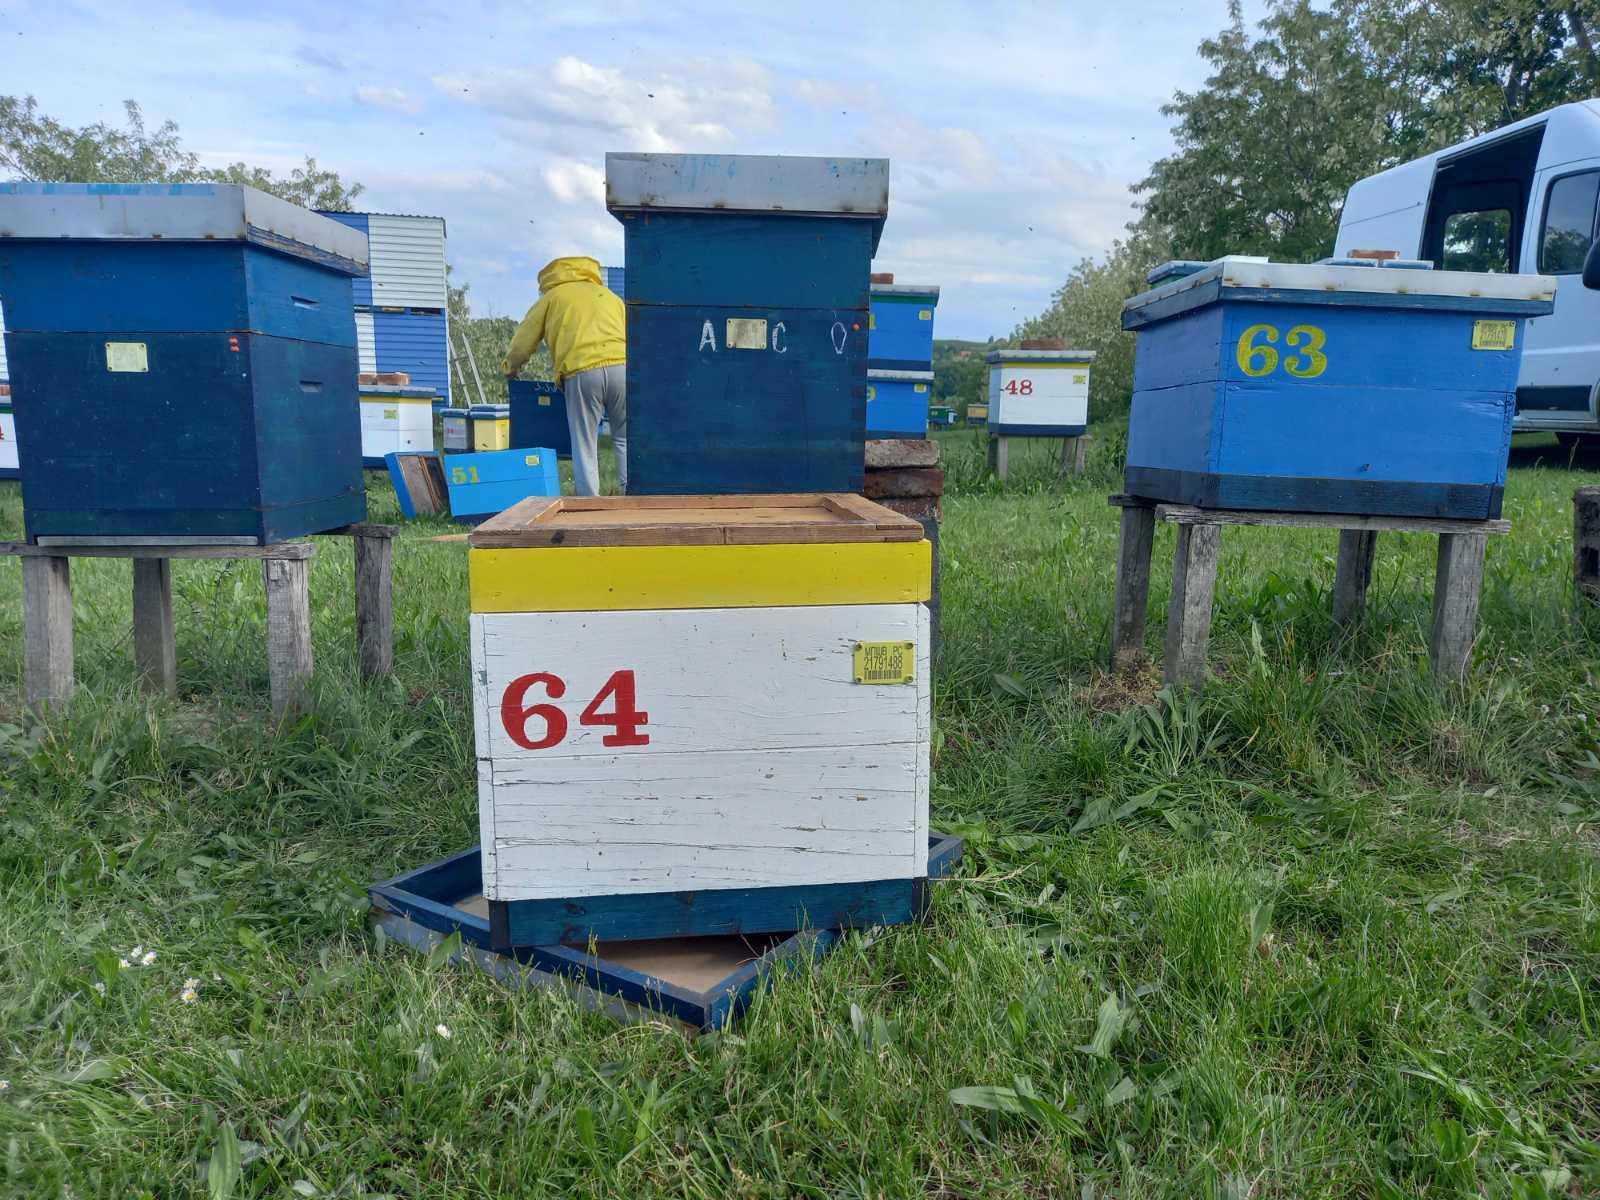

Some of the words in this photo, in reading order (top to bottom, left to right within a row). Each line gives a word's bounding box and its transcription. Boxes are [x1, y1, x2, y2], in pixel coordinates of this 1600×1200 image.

[1236, 323, 1328, 378] 63
[1005, 379, 1033, 396] 48
[452, 466, 480, 485] 51
[863, 655, 903, 670] 21791488
[501, 669, 650, 750] 64
